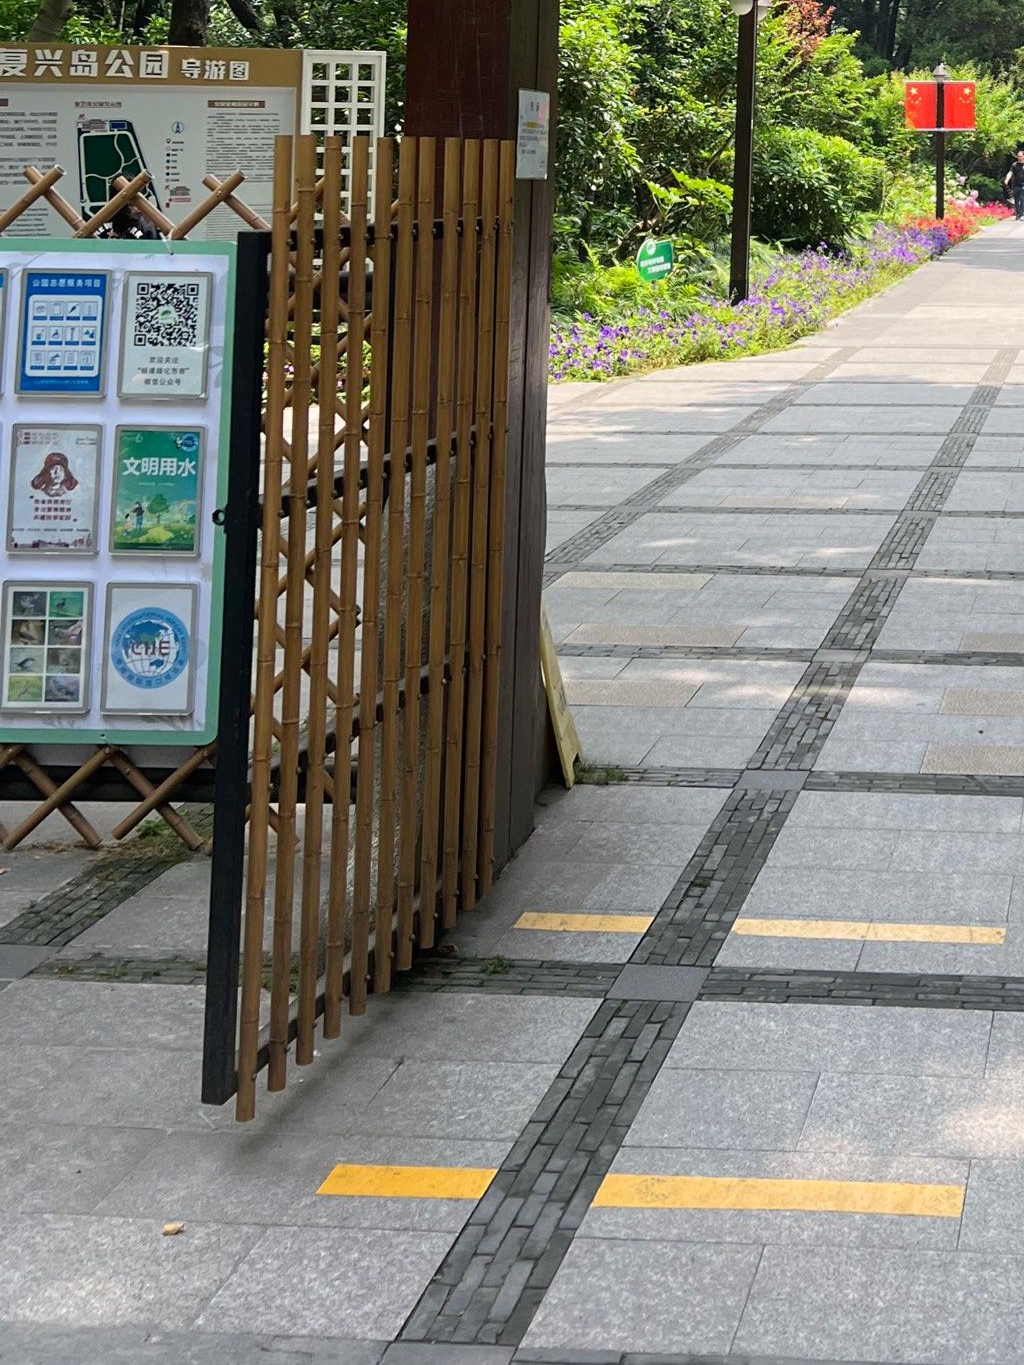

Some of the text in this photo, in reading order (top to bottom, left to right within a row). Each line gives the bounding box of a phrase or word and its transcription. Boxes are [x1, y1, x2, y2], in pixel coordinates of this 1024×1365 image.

[0, 47, 250, 81] 复兴岛公园 导游图
[122, 457, 196, 477] 文明用水
